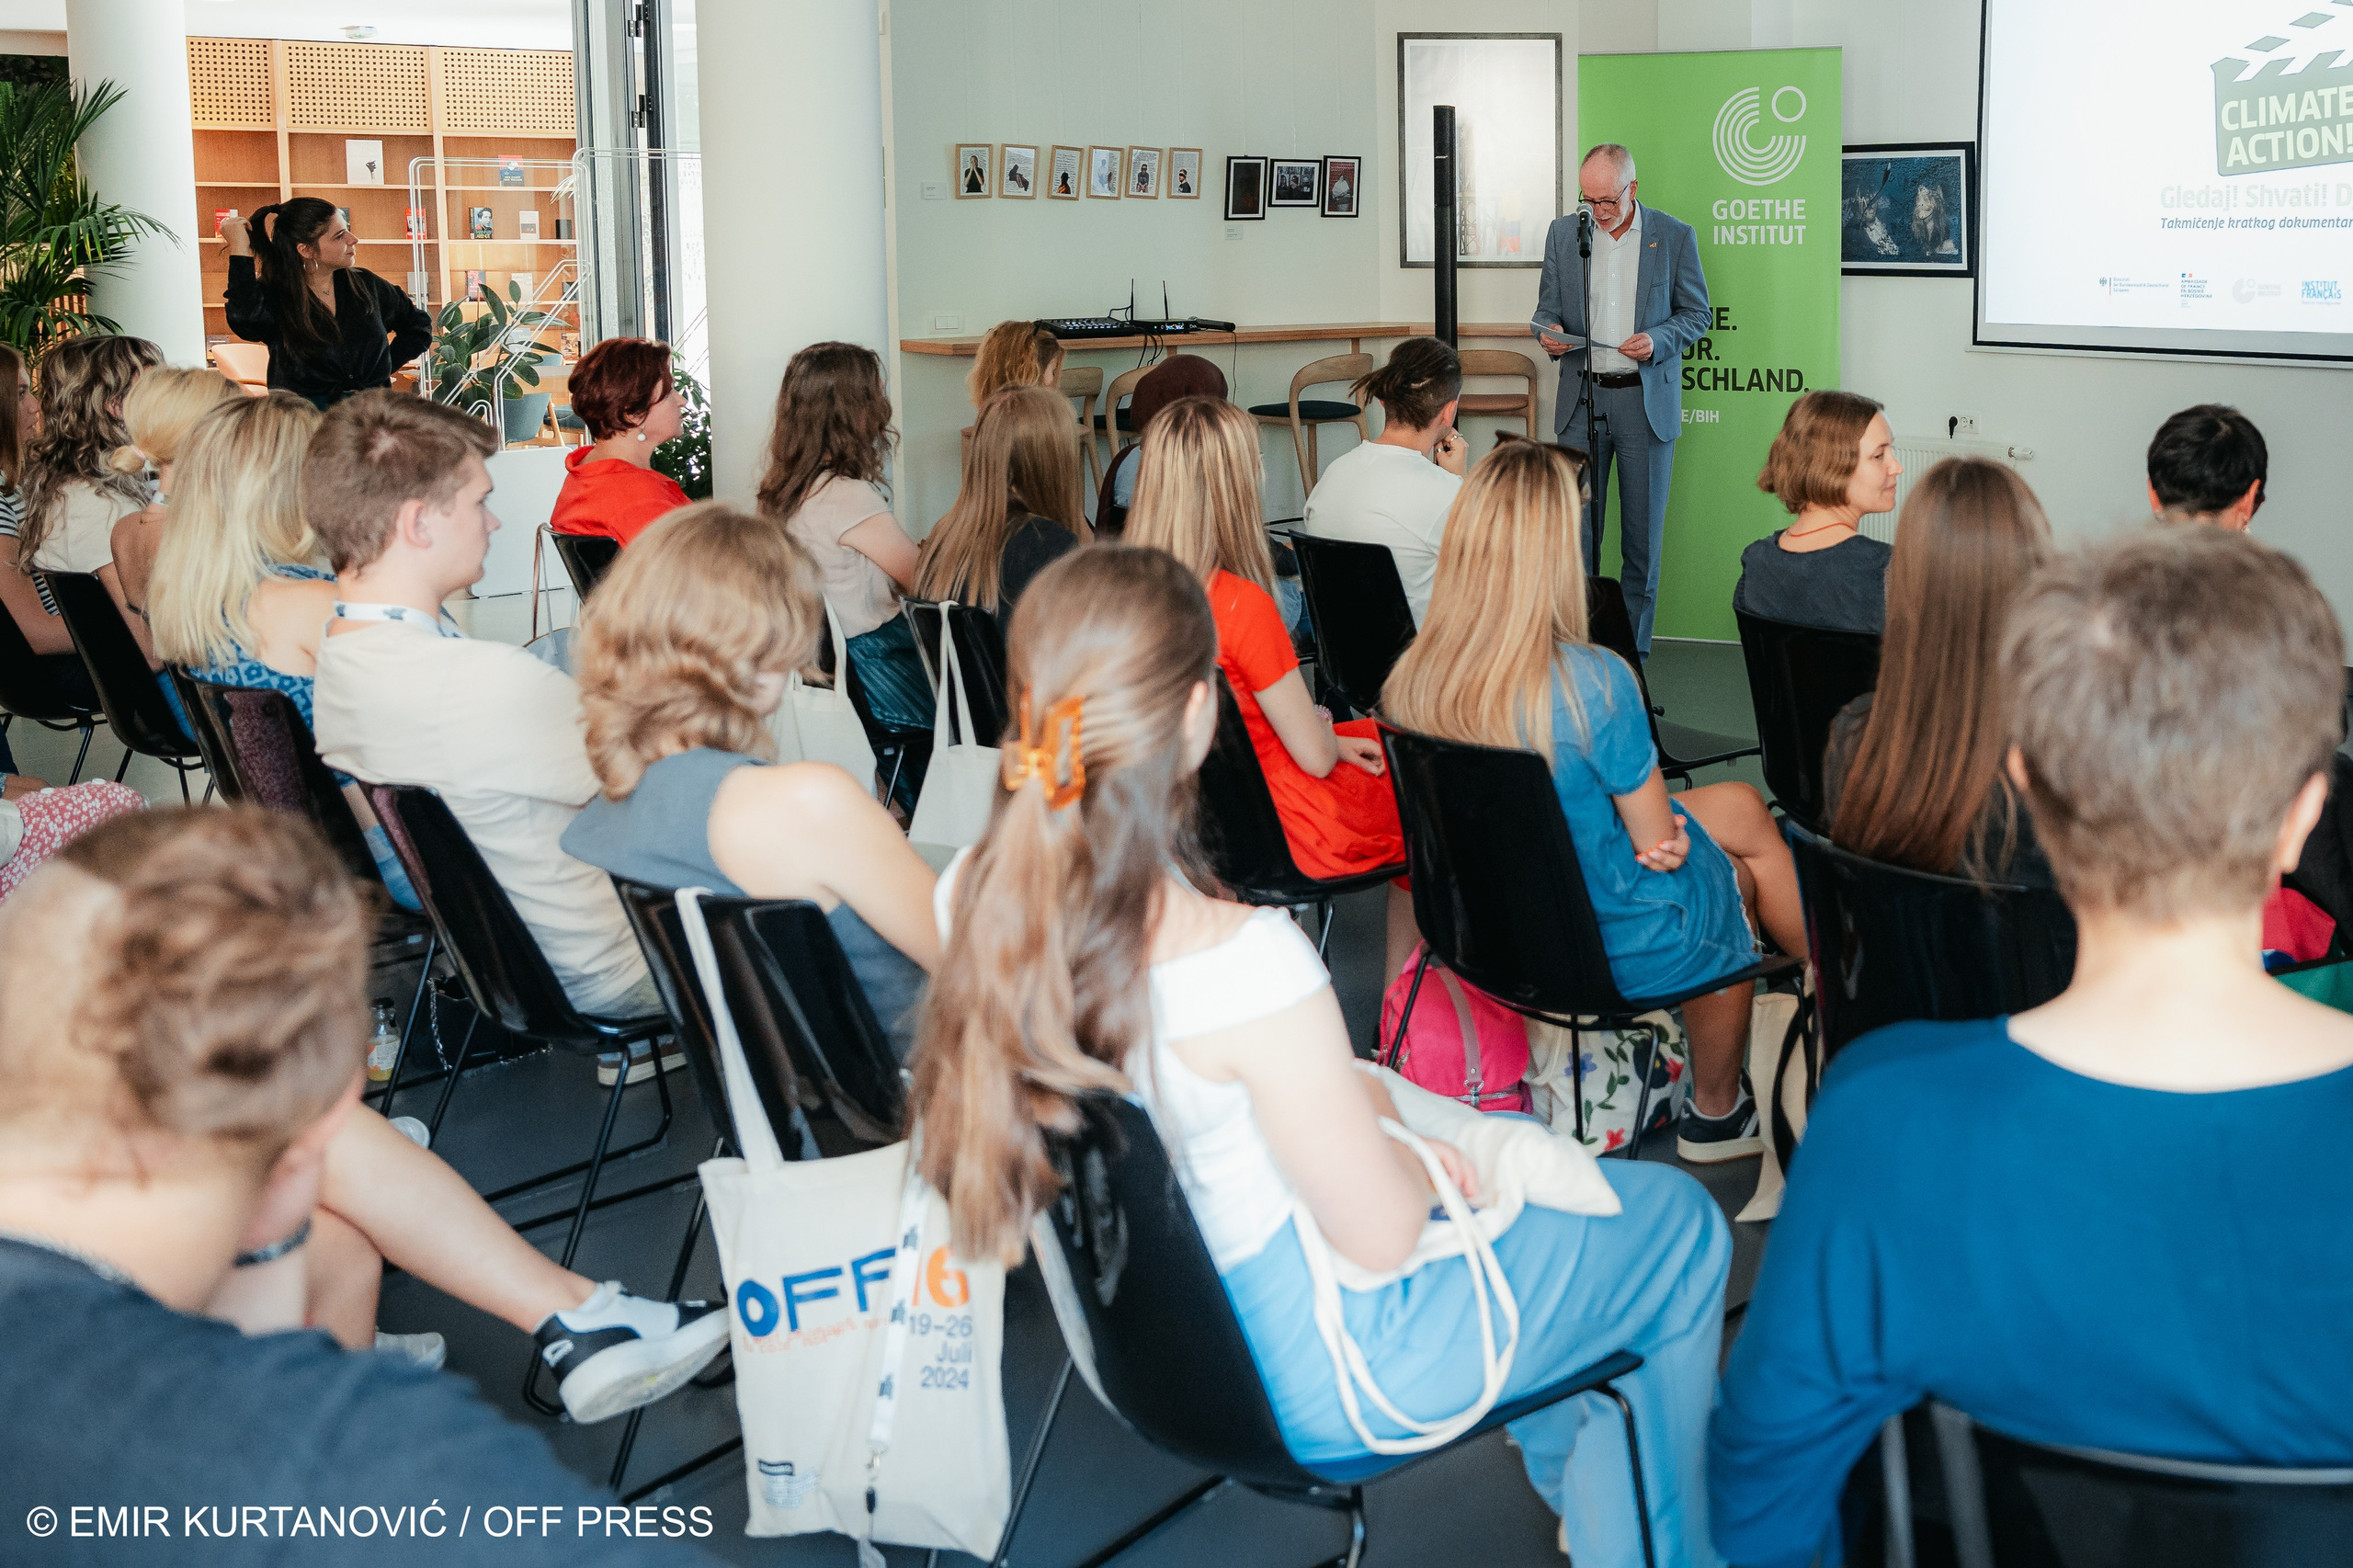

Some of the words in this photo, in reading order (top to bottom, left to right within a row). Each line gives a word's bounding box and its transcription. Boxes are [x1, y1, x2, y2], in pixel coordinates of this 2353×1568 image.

[2221, 85, 2353, 131] CLIMATE
[2226, 122, 2353, 168] ACTION!
[2160, 184, 2238, 212] Gledaj!
[2245, 182, 2327, 208] Shvati!
[2336, 183, 2353, 209] D
[1712, 199, 1806, 221] GOETHE
[1713, 224, 1806, 245] INSTITUT
[2160, 217, 2225, 231] Takmičenje
[2228, 216, 2276, 230] kratkog
[2279, 216, 2353, 229] dokumentar
[2302, 280, 2337, 291] INSTITUT
[1681, 366, 1809, 392] SCHLAND.
[1681, 408, 1720, 425] E/BIH
[736, 1245, 897, 1338] OFF
[936, 1341, 972, 1363] Juli
[921, 1366, 970, 1389] 2024
